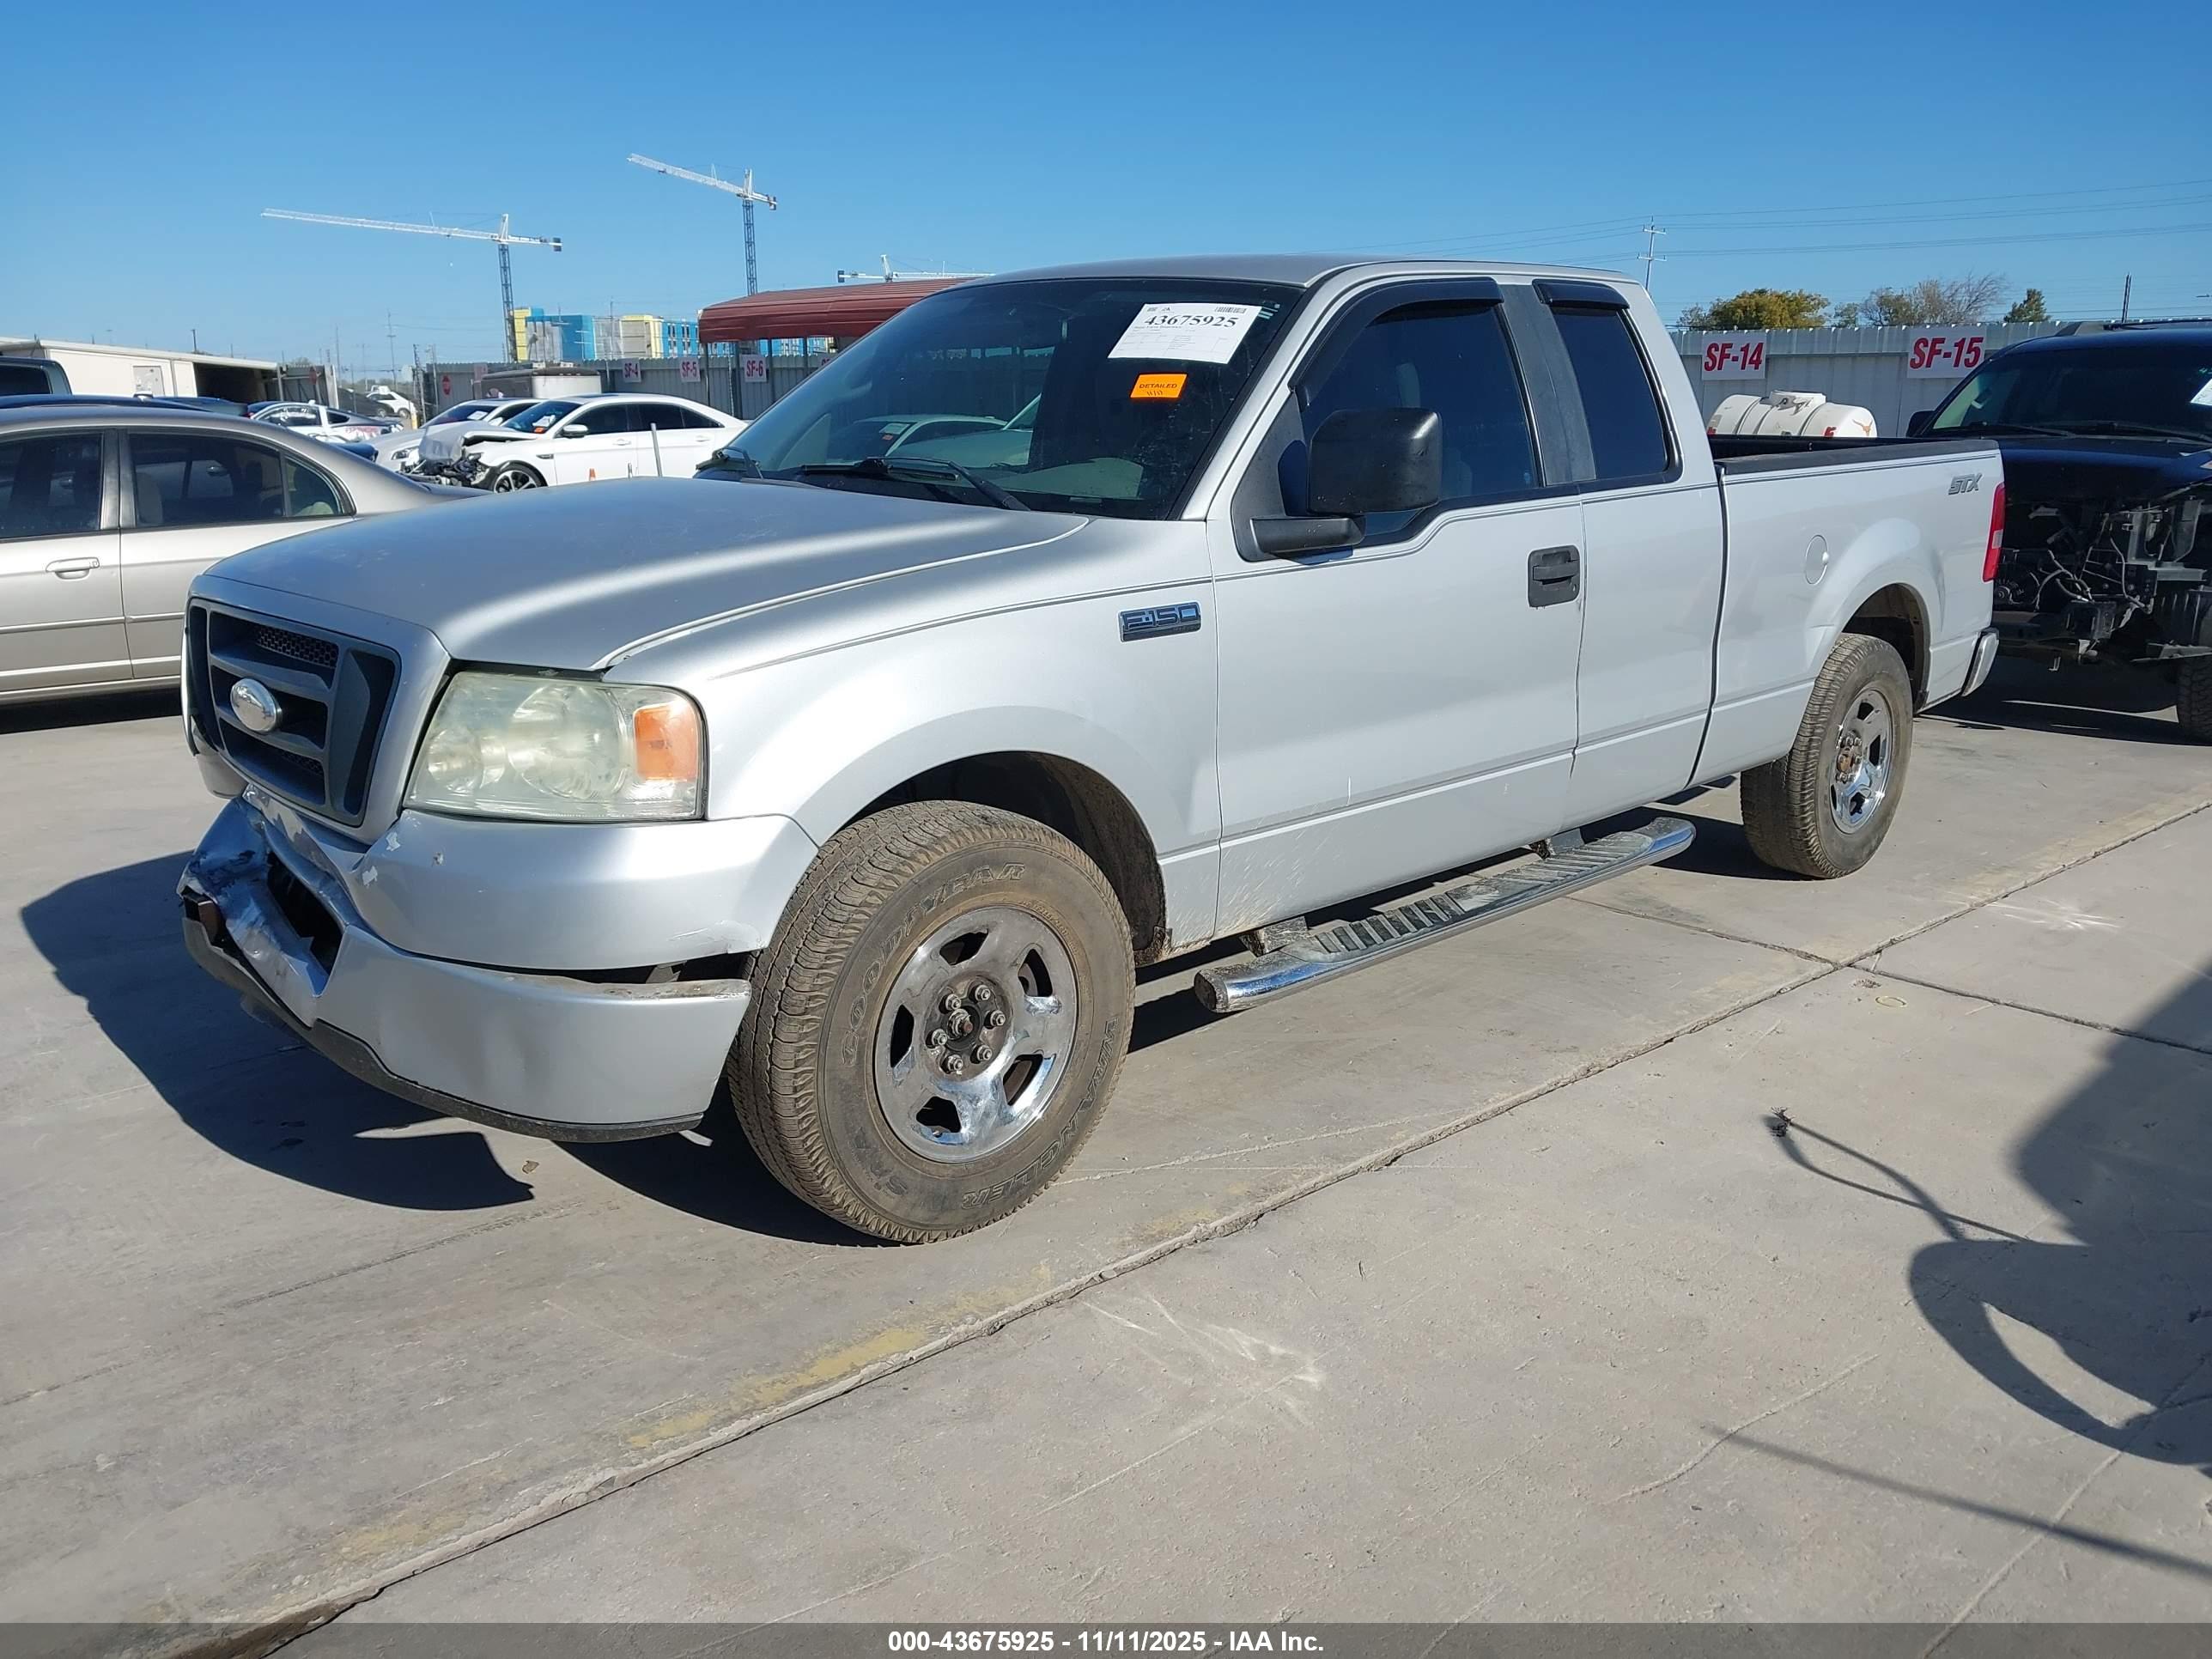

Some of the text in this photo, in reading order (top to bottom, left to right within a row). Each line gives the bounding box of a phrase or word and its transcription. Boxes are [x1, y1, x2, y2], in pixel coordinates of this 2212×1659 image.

[1145, 315, 1239, 328] 43675925
[1704, 343, 1764, 371] SF-14
[1910, 337, 1984, 369] SF-15
[624, 362, 638, 378] SF-4
[682, 362, 697, 377] SF-5
[746, 360, 763, 377] SF-6
[1948, 473, 1983, 495] STX
[842, 862, 1025, 1066] GOODYEAR
[961, 1018, 1119, 1210] WRANGLER
